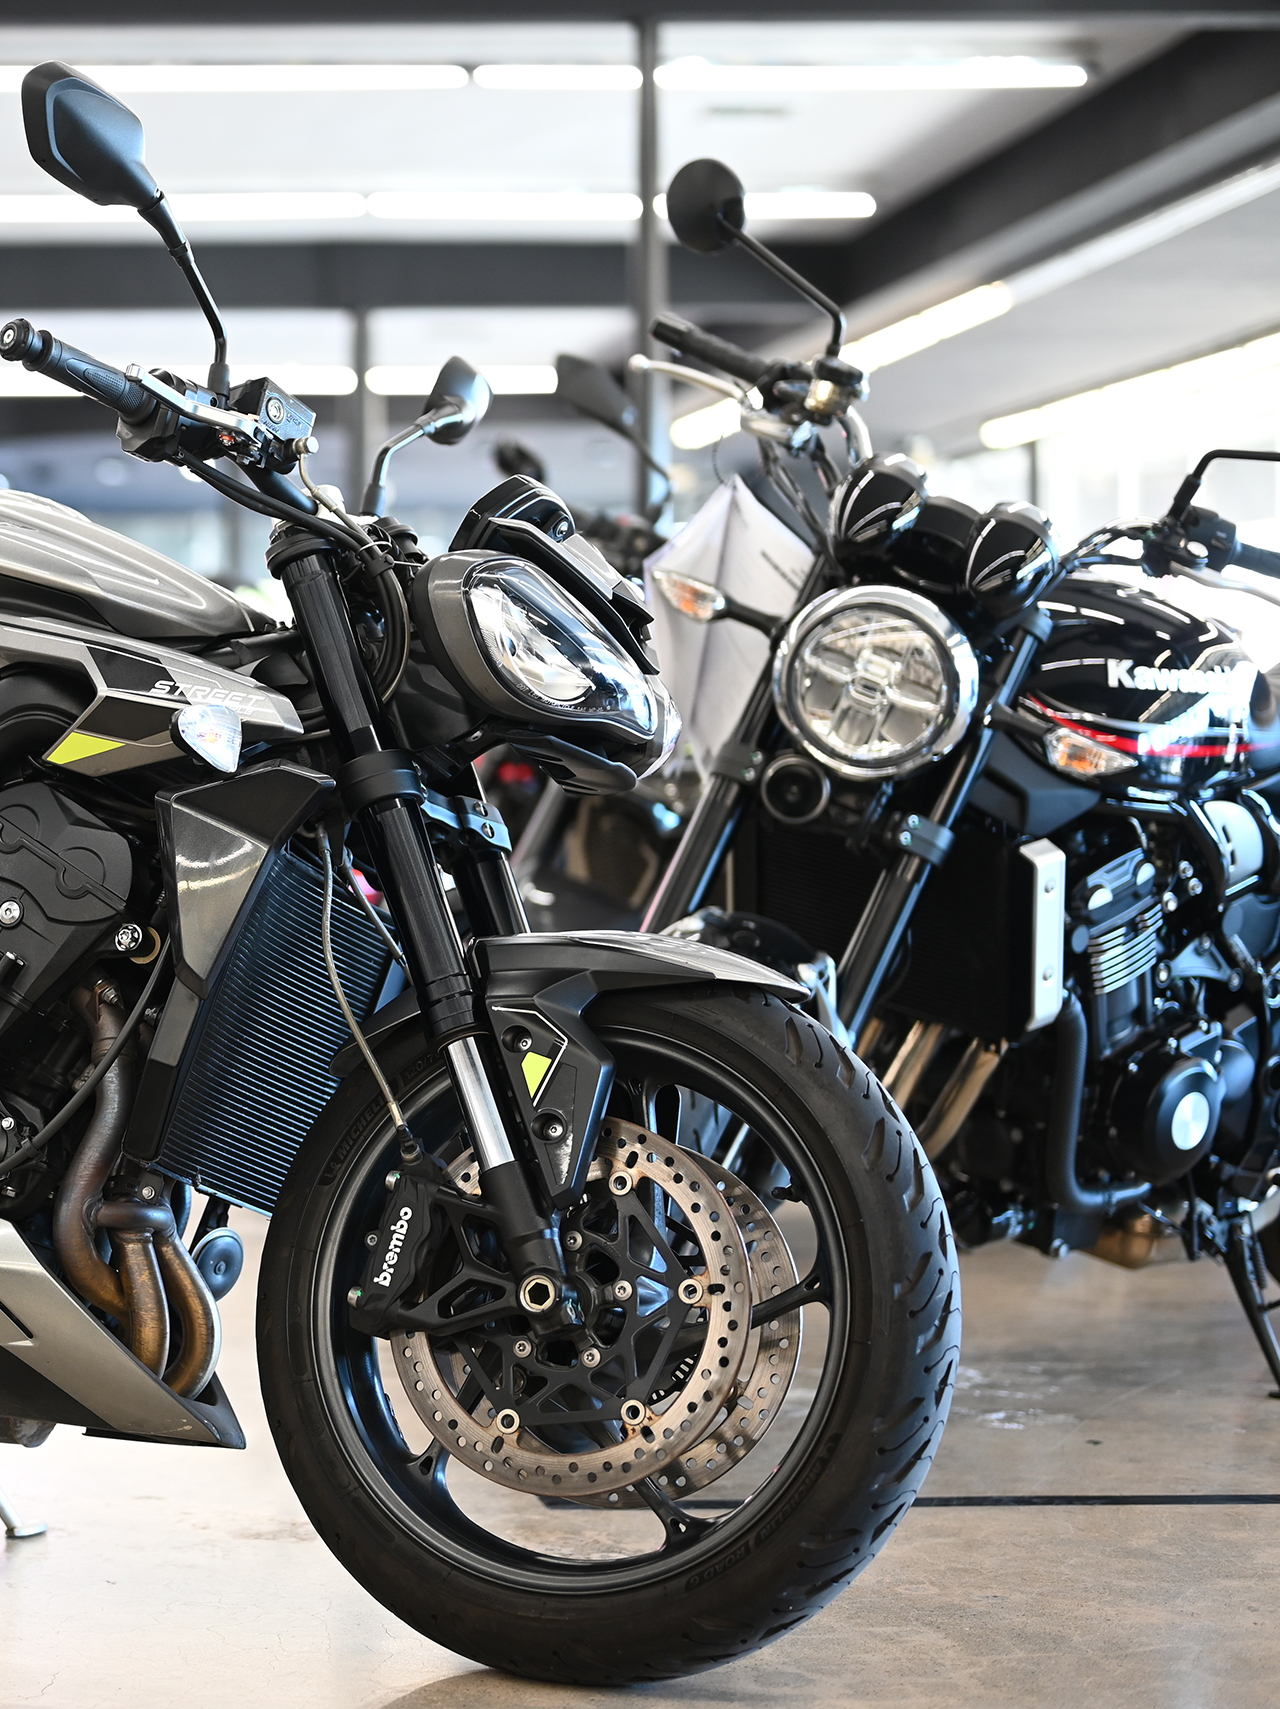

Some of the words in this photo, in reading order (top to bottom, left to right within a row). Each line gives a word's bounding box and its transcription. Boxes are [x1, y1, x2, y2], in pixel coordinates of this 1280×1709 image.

[149, 679, 266, 708] STREET
[336, 1095, 387, 1161] MICHELI
[373, 1206, 413, 1287] brembo
[758, 1463, 821, 1540] MICHELIN
[703, 1545, 746, 1579] ROAD
